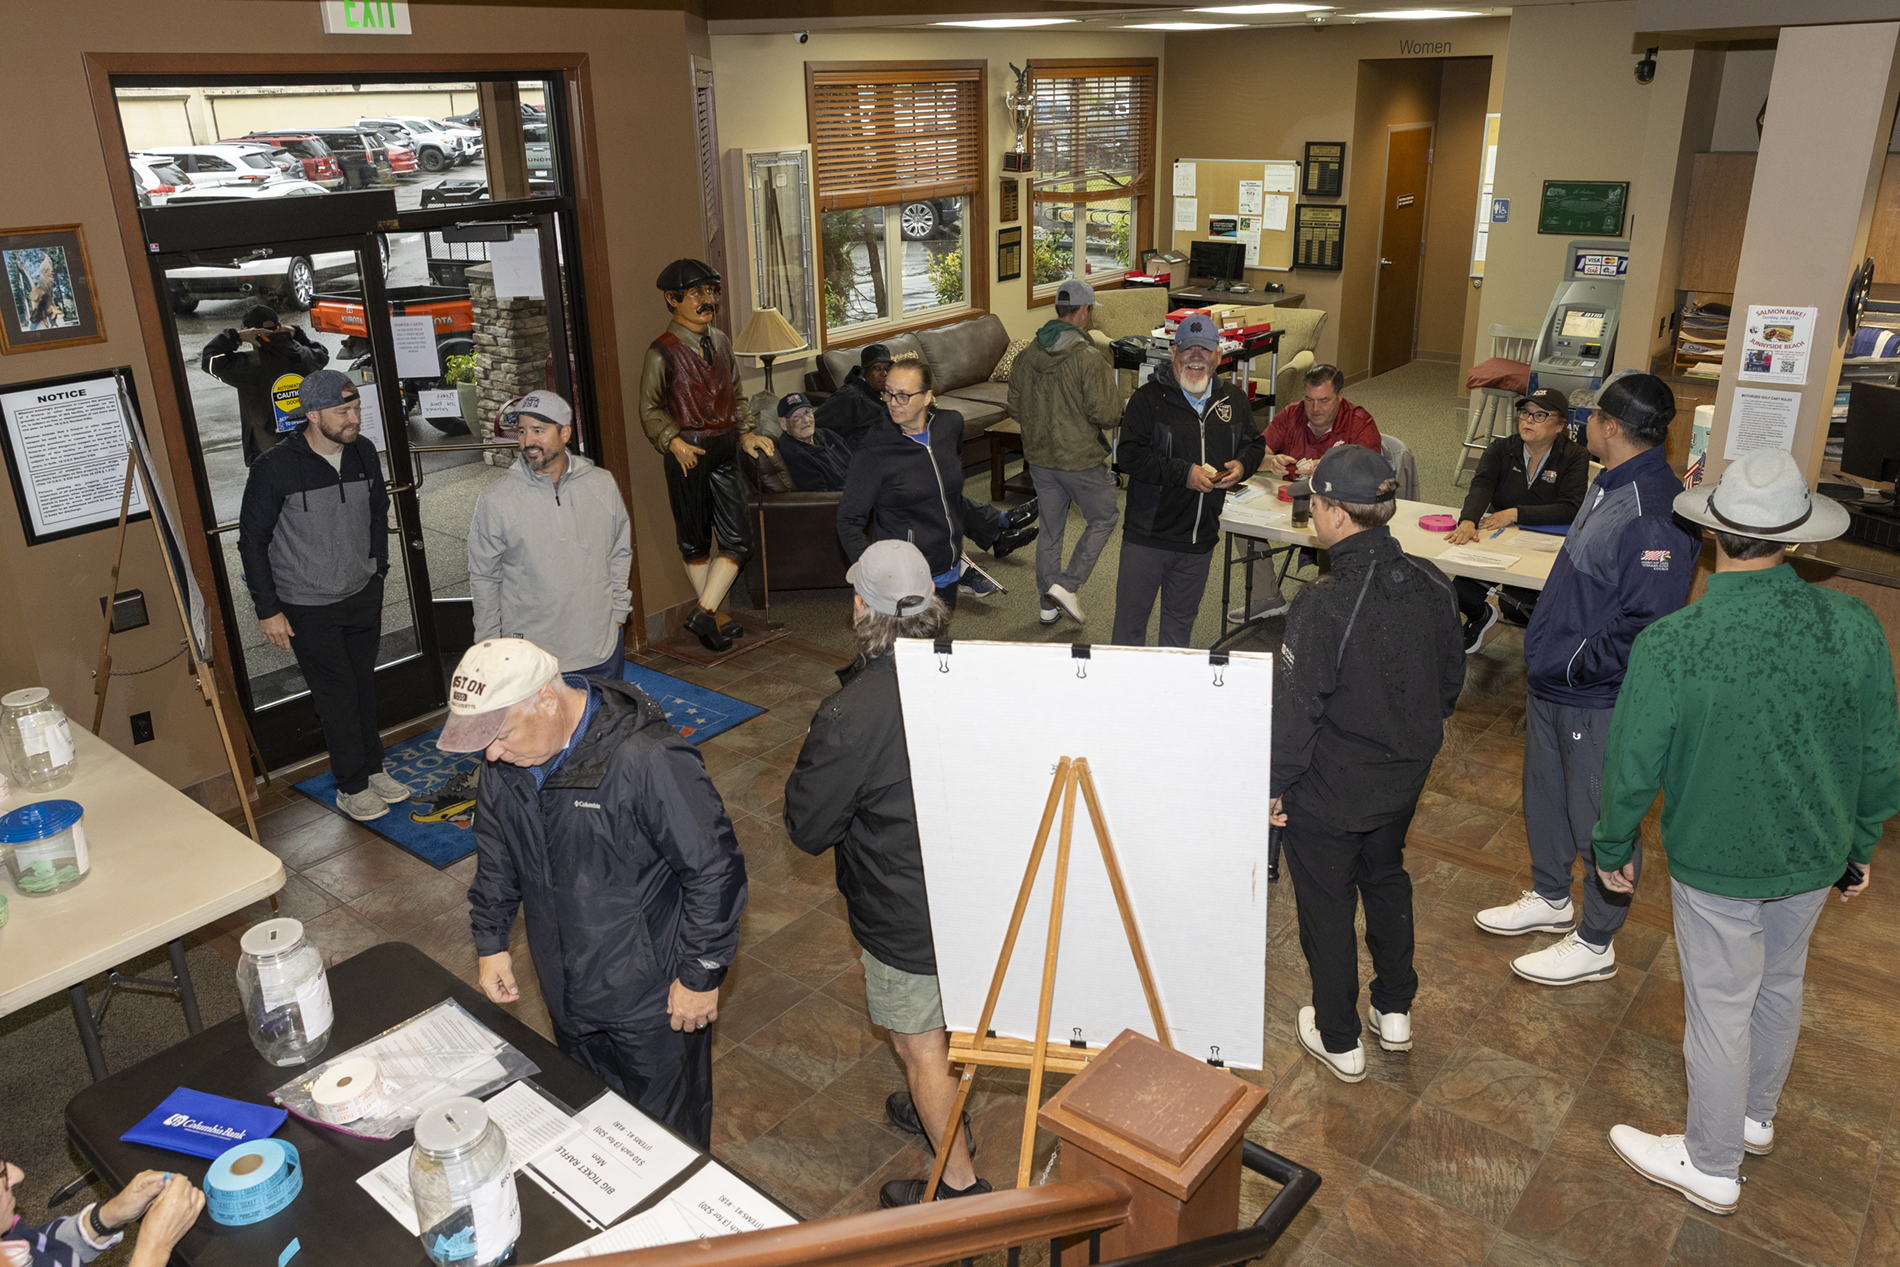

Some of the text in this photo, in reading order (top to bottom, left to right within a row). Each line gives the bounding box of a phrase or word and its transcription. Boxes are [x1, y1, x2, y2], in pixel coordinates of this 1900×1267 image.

[1400, 40, 1452, 54] Women
[1786, 310, 1806, 318] BAKE!
[341, 315, 364, 325] KUBOTA
[433, 316, 454, 326] OTA
[1749, 338, 1805, 349] SUNNYSIDE BEACH
[37, 389, 87, 403] NOTICE
[277, 391, 299, 399] CAUTI
[580, 801, 601, 809] Columbia
[364, 1098, 377, 1111] TICKET
[182, 1120, 223, 1135] Columbia
[223, 1128, 246, 1140] Bank
[594, 1126, 608, 1137] $20)
[613, 1121, 625, 1131] #18)
[606, 1136, 616, 1144] for
[633, 1137, 652, 1151] (ITEMS
[621, 1146, 634, 1157] each
[592, 1154, 607, 1166] Men
[632, 1156, 645, 1166] $10
[555, 1146, 615, 1194] BIG TICKET RAFFLE
[266, 1187, 281, 1197] TICKET
[718, 1195, 732, 1206] #18)
[698, 1201, 742, 1235] ach (3 for $20)
[742, 1213, 764, 1232] (ITEMS
